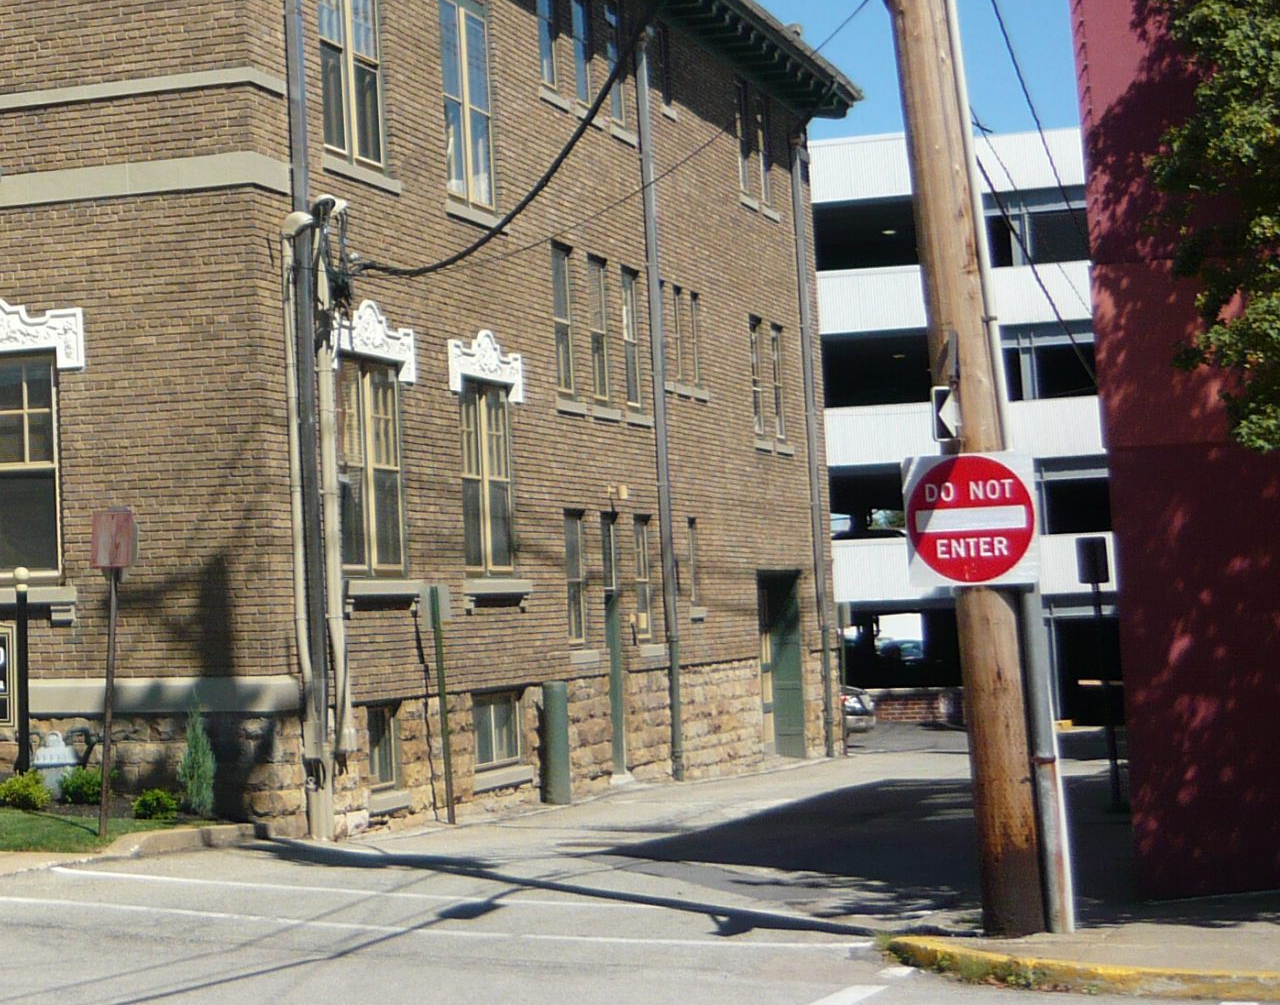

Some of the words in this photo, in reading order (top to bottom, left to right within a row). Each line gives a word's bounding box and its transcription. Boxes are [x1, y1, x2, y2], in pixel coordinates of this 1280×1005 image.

[925, 482, 954, 502] DO
[969, 479, 1013, 500] NOT
[936, 537, 1008, 558] ENTER
